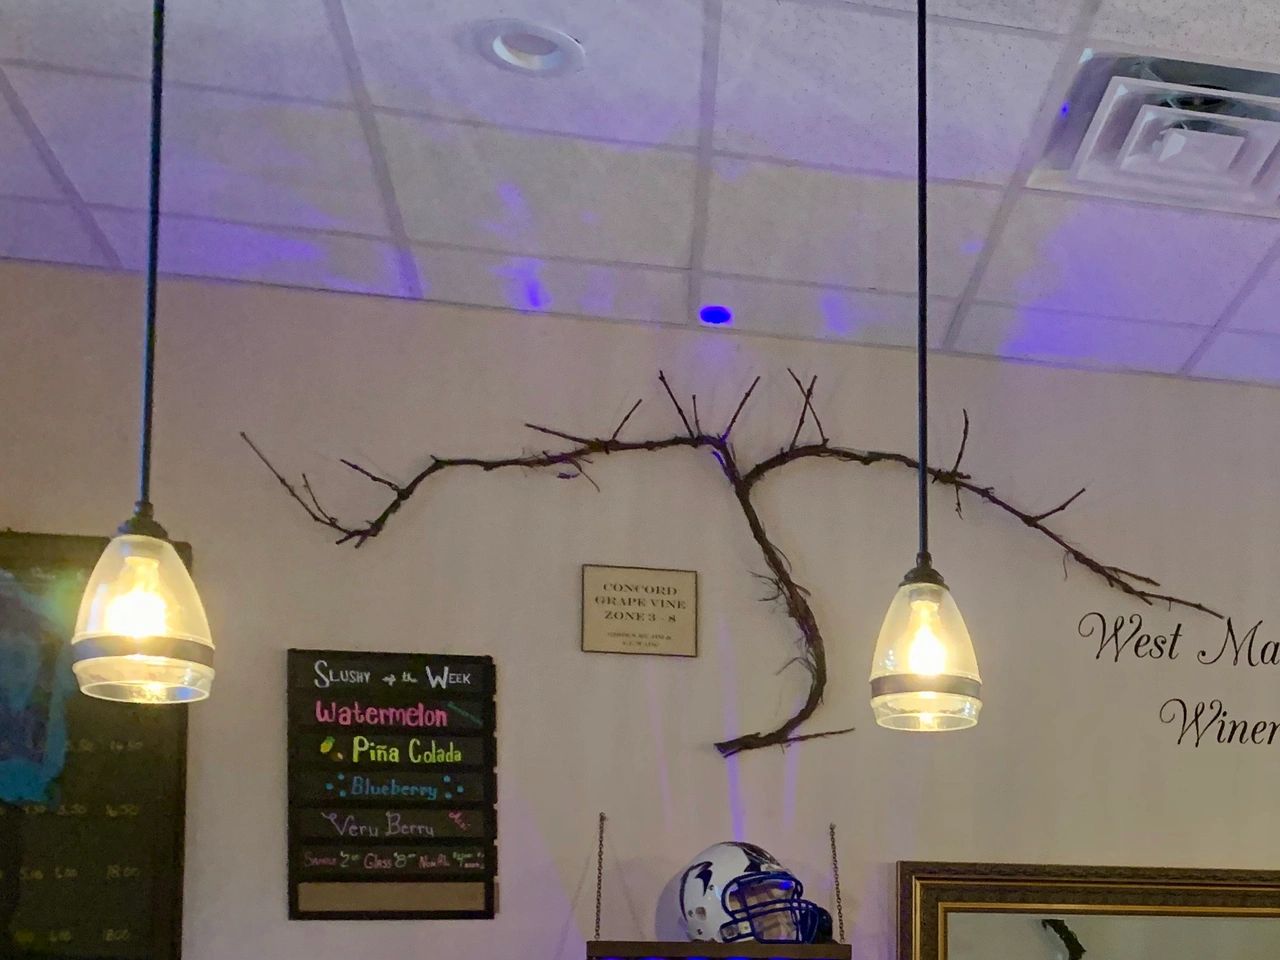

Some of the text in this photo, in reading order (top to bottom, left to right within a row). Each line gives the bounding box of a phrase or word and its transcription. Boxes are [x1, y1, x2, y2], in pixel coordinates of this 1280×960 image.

[603, 583, 678, 596] CONCORD
[604, 610, 646, 621] ZONE
[1078, 612, 1183, 662] West
[426, 665, 471, 689] WEEK
[315, 700, 448, 728] Watermelon
[352, 735, 462, 764] Piña Colada
[351, 776, 438, 800] Blueberry
[384, 811, 434, 837] Berry
